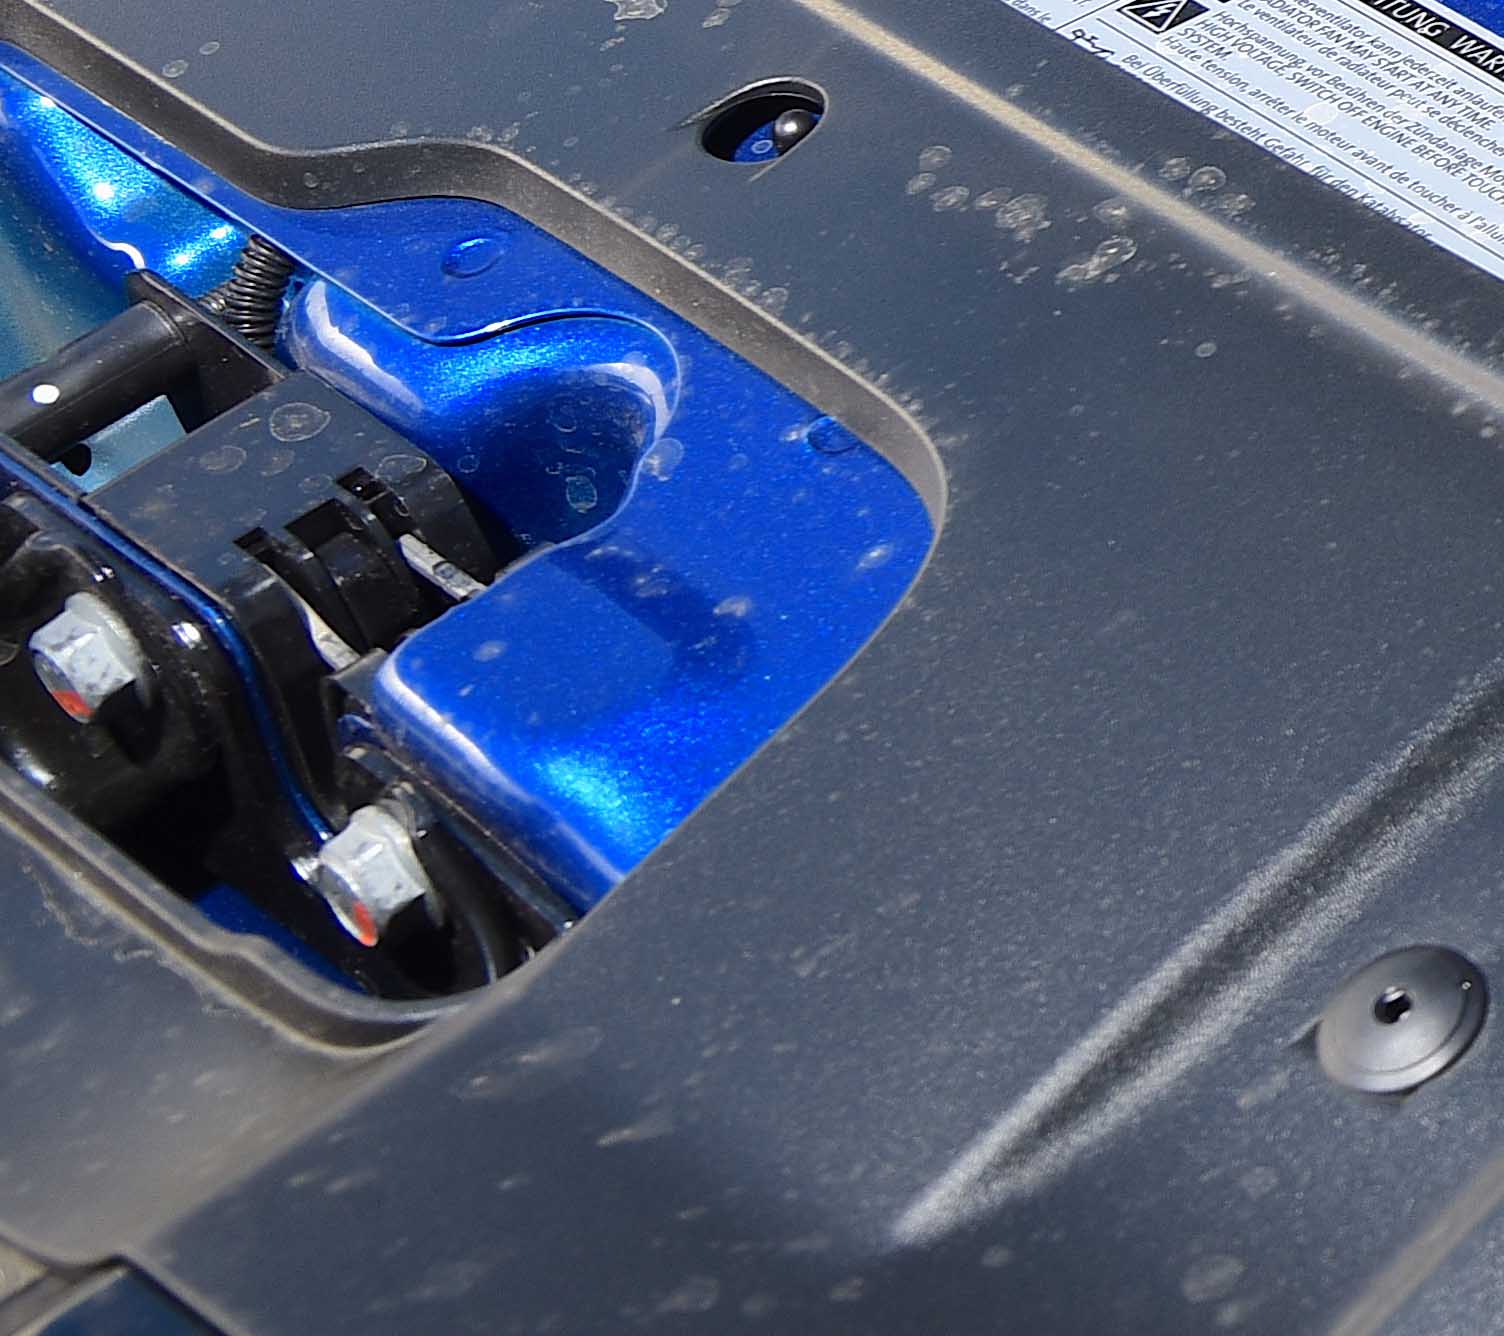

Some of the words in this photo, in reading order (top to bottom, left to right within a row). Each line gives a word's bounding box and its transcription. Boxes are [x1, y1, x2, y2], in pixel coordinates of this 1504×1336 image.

[1157, 34, 1207, 62] Haute
[1173, 26, 1239, 61] SYSTEM.
[1119, 53, 1151, 70] Bei
[1194, 58, 1258, 93] tension,
[1247, 6, 1326, 49] ventilateur
[1314, 43, 1343, 59] de
[1331, 53, 1401, 92] radiateur
[1385, 86, 1428, 110] peut
[1419, 105, 1443, 118] se
[1312, 24, 1349, 44] FAN
[1339, 39, 1379, 61] MAY
[1369, 57, 1417, 83] START
[1407, 78, 1435, 93] AT
[1424, 88, 1464, 110] ANY
[1452, 104, 1501, 131] TIME.
[1364, 36, 1406, 59] kann
[1391, 54, 1460, 92] jederzeit
[1133, 63, 1228, 115] Überfüllung
[1191, 18, 1237, 43] HIGH
[1283, 70, 1345, 104] SWITCH
[1333, 99, 1369, 119] OFF
[1358, 114, 1419, 148] ENGINE
[1407, 143, 1469, 177] BEFORE
[1245, 87, 1299, 117] arrêter
[1211, 107, 1273, 141] besteht
[1289, 111, 1313, 124] le
[1301, 63, 1331, 80] vor
[1321, 74, 1391, 113] Berühren
[1379, 107, 1413, 126] der
[1397, 120, 1490, 172] Zündanlage
[1300, 119, 1359, 152] moteur
[1347, 147, 1395, 174] avant
[1385, 168, 1415, 185] de
[1403, 179, 1467, 215] toucher
